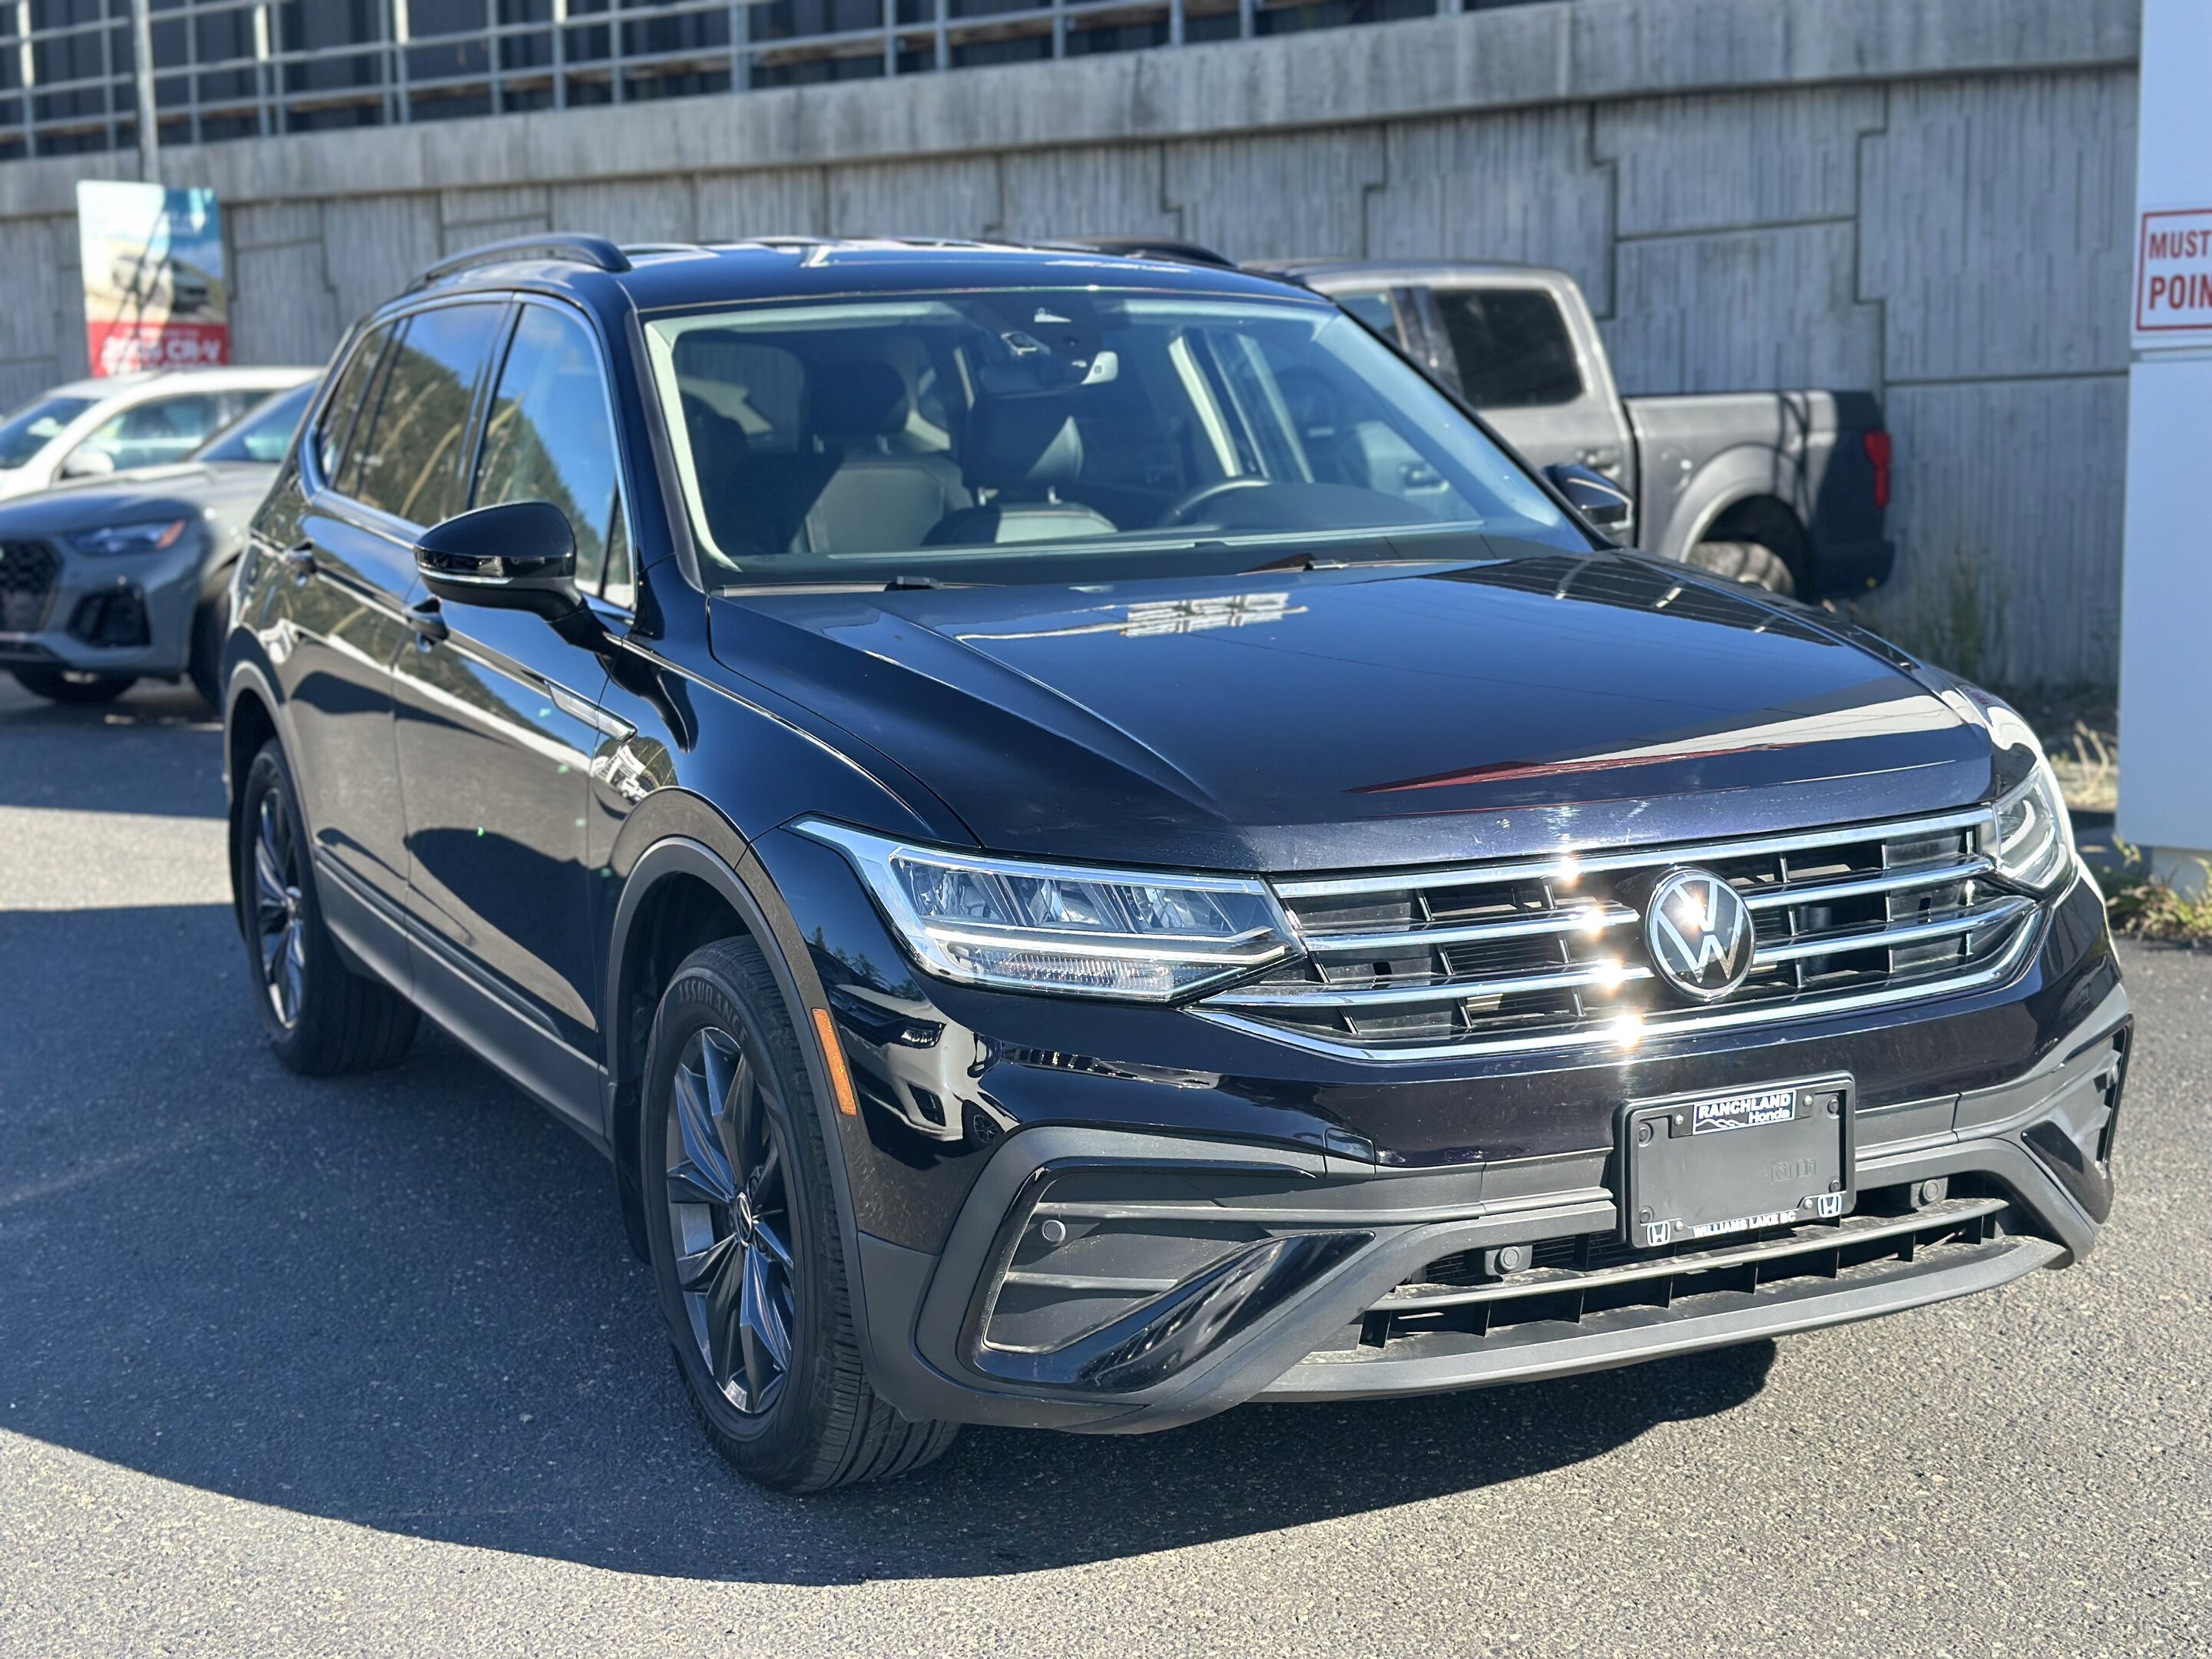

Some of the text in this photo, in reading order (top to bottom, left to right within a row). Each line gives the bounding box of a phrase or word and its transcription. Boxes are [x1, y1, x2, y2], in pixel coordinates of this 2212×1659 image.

[2150, 231, 2212, 258] MUST
[1698, 1093, 1791, 1119] RANCHLAND
[1748, 1108, 1791, 1124] Honda
[1693, 1210, 1796, 1238] WILLIAMS LAKE BC
